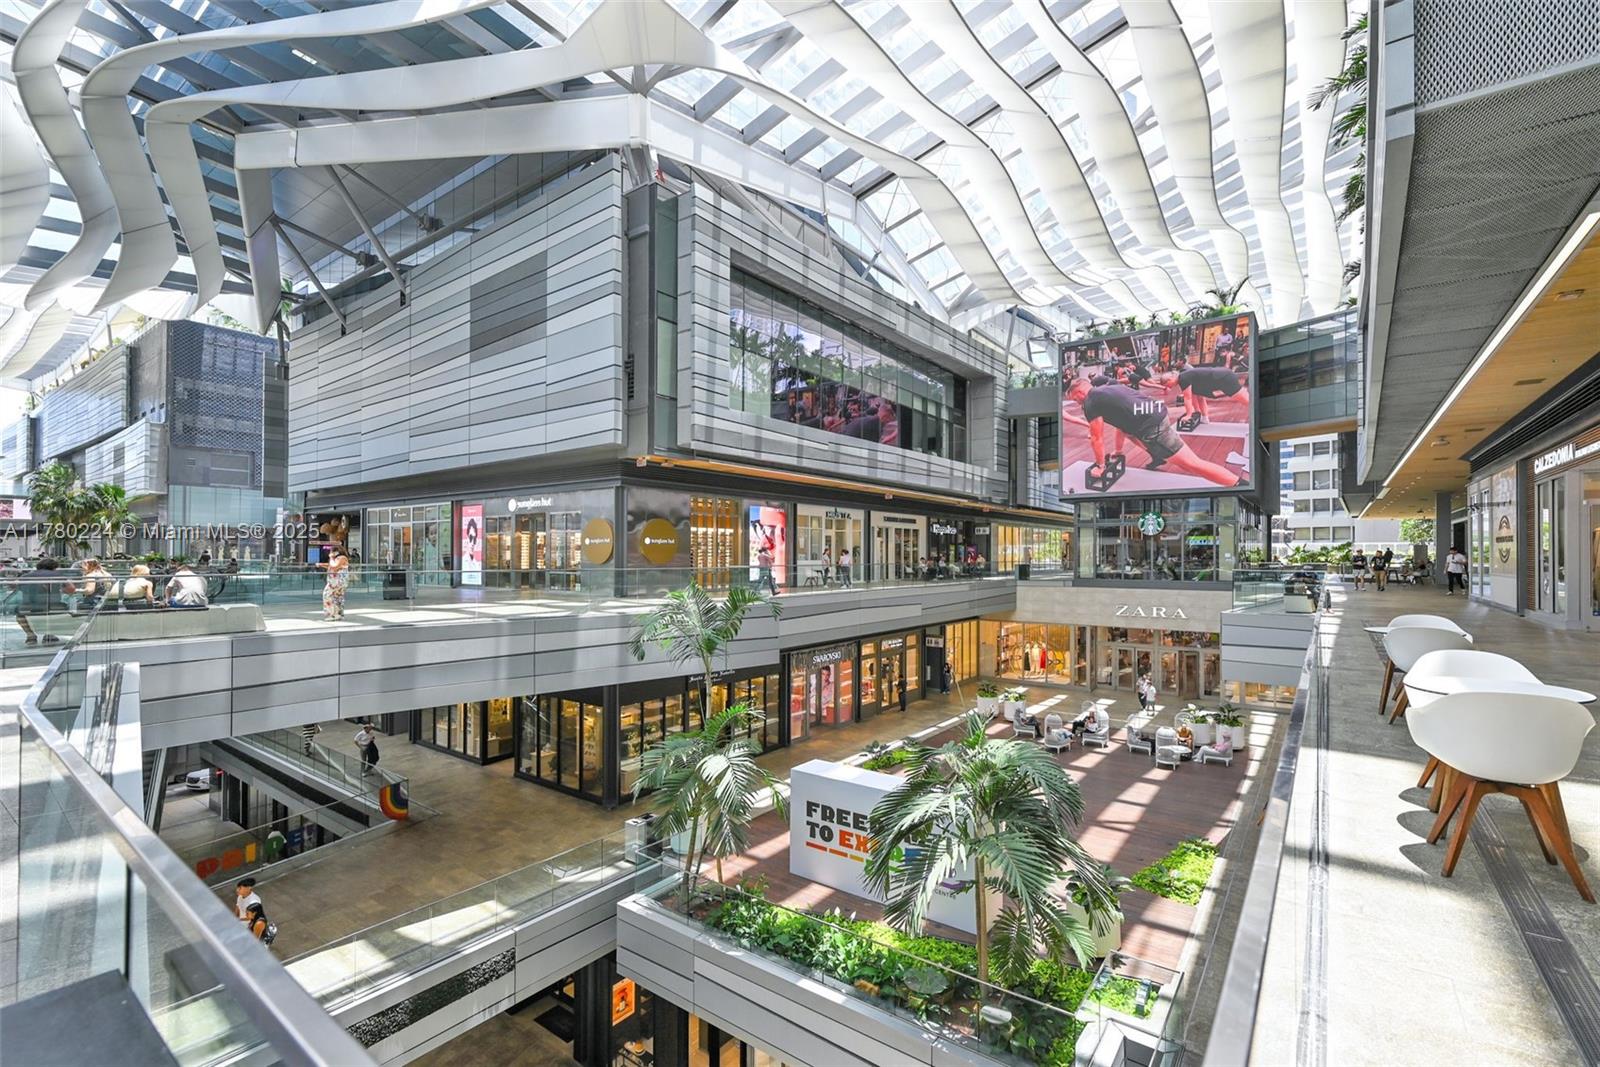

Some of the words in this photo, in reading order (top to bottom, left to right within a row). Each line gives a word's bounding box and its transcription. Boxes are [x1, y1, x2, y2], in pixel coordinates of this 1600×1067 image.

[1133, 400, 1165, 416] HIIT
[1534, 443, 1574, 475] CALZEDONIA
[1113, 604, 1188, 619] ZARA
[806, 820, 834, 843] TO
